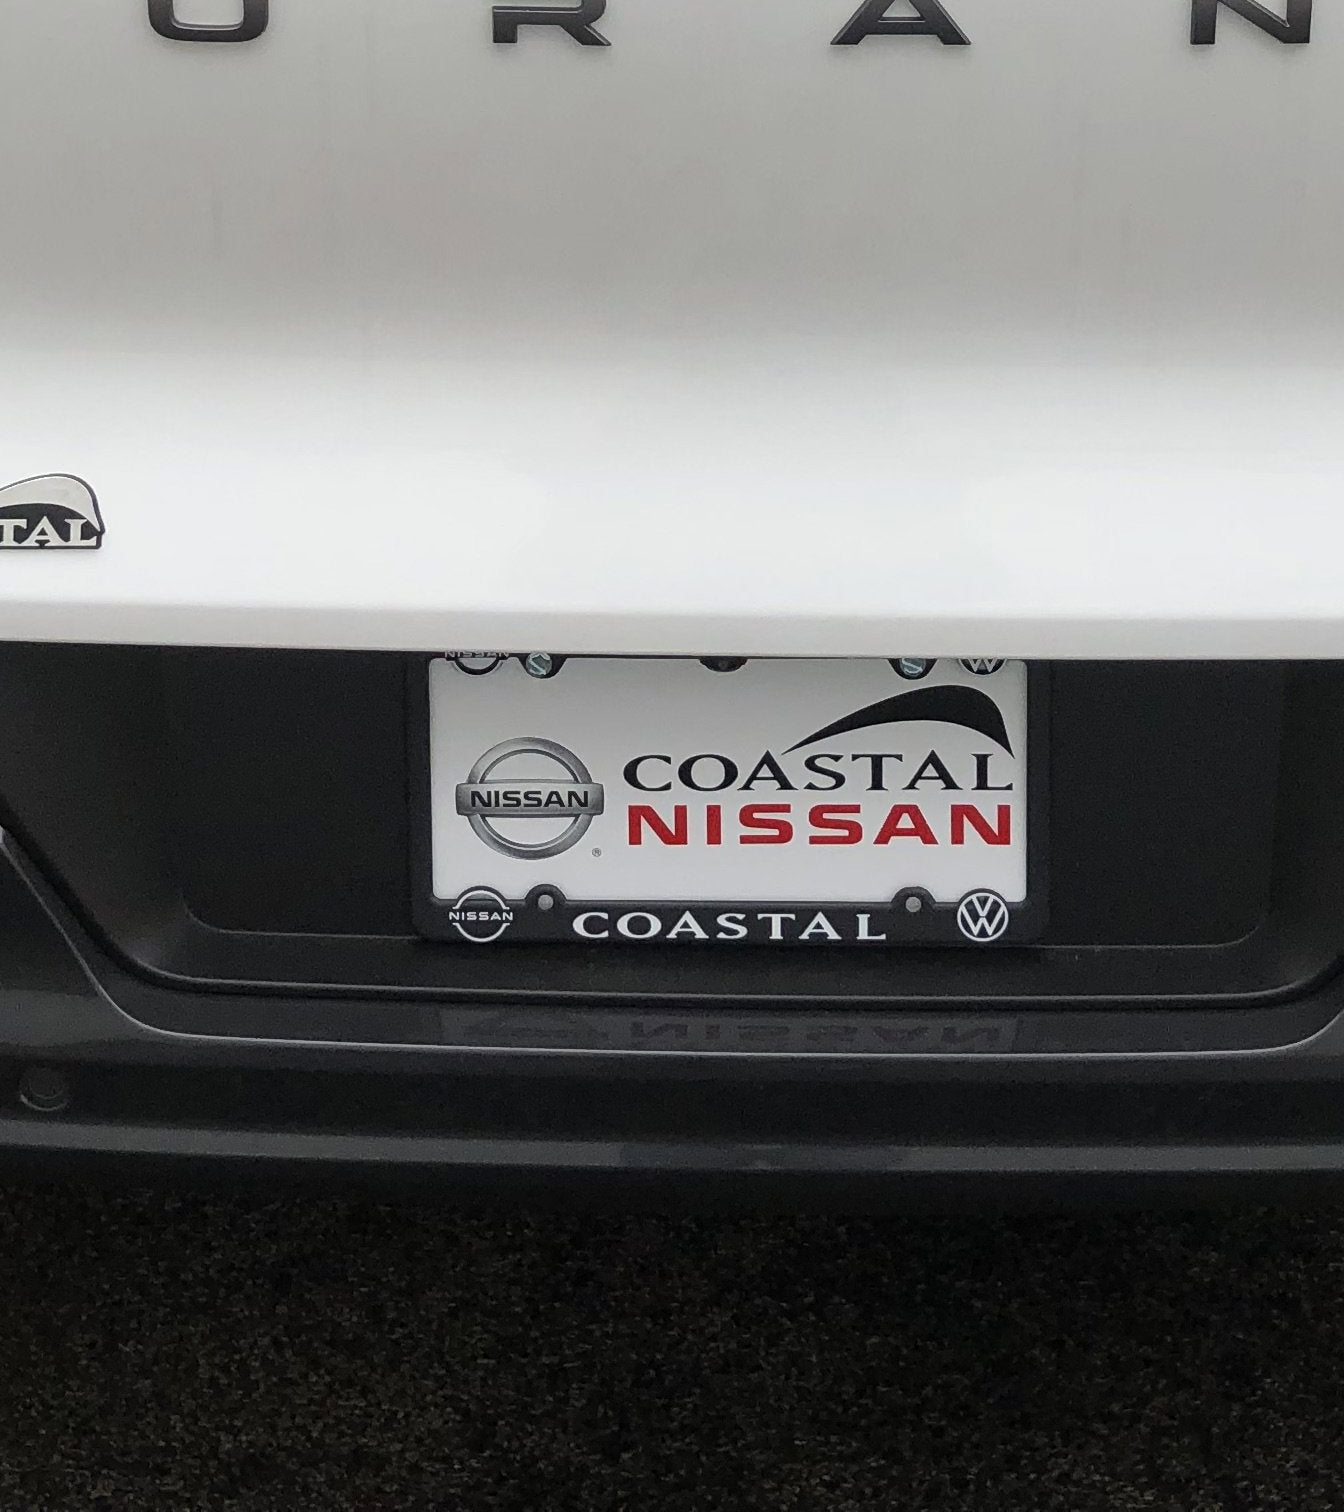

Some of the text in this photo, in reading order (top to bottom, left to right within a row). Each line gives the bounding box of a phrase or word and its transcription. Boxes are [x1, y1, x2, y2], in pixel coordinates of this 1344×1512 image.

[622, 749, 1014, 792] COASTAL
[470, 788, 589, 809] NISSAN
[627, 804, 1011, 846] NISSAN
[449, 911, 514, 921] NISSAN
[573, 910, 886, 942] COASTAL
